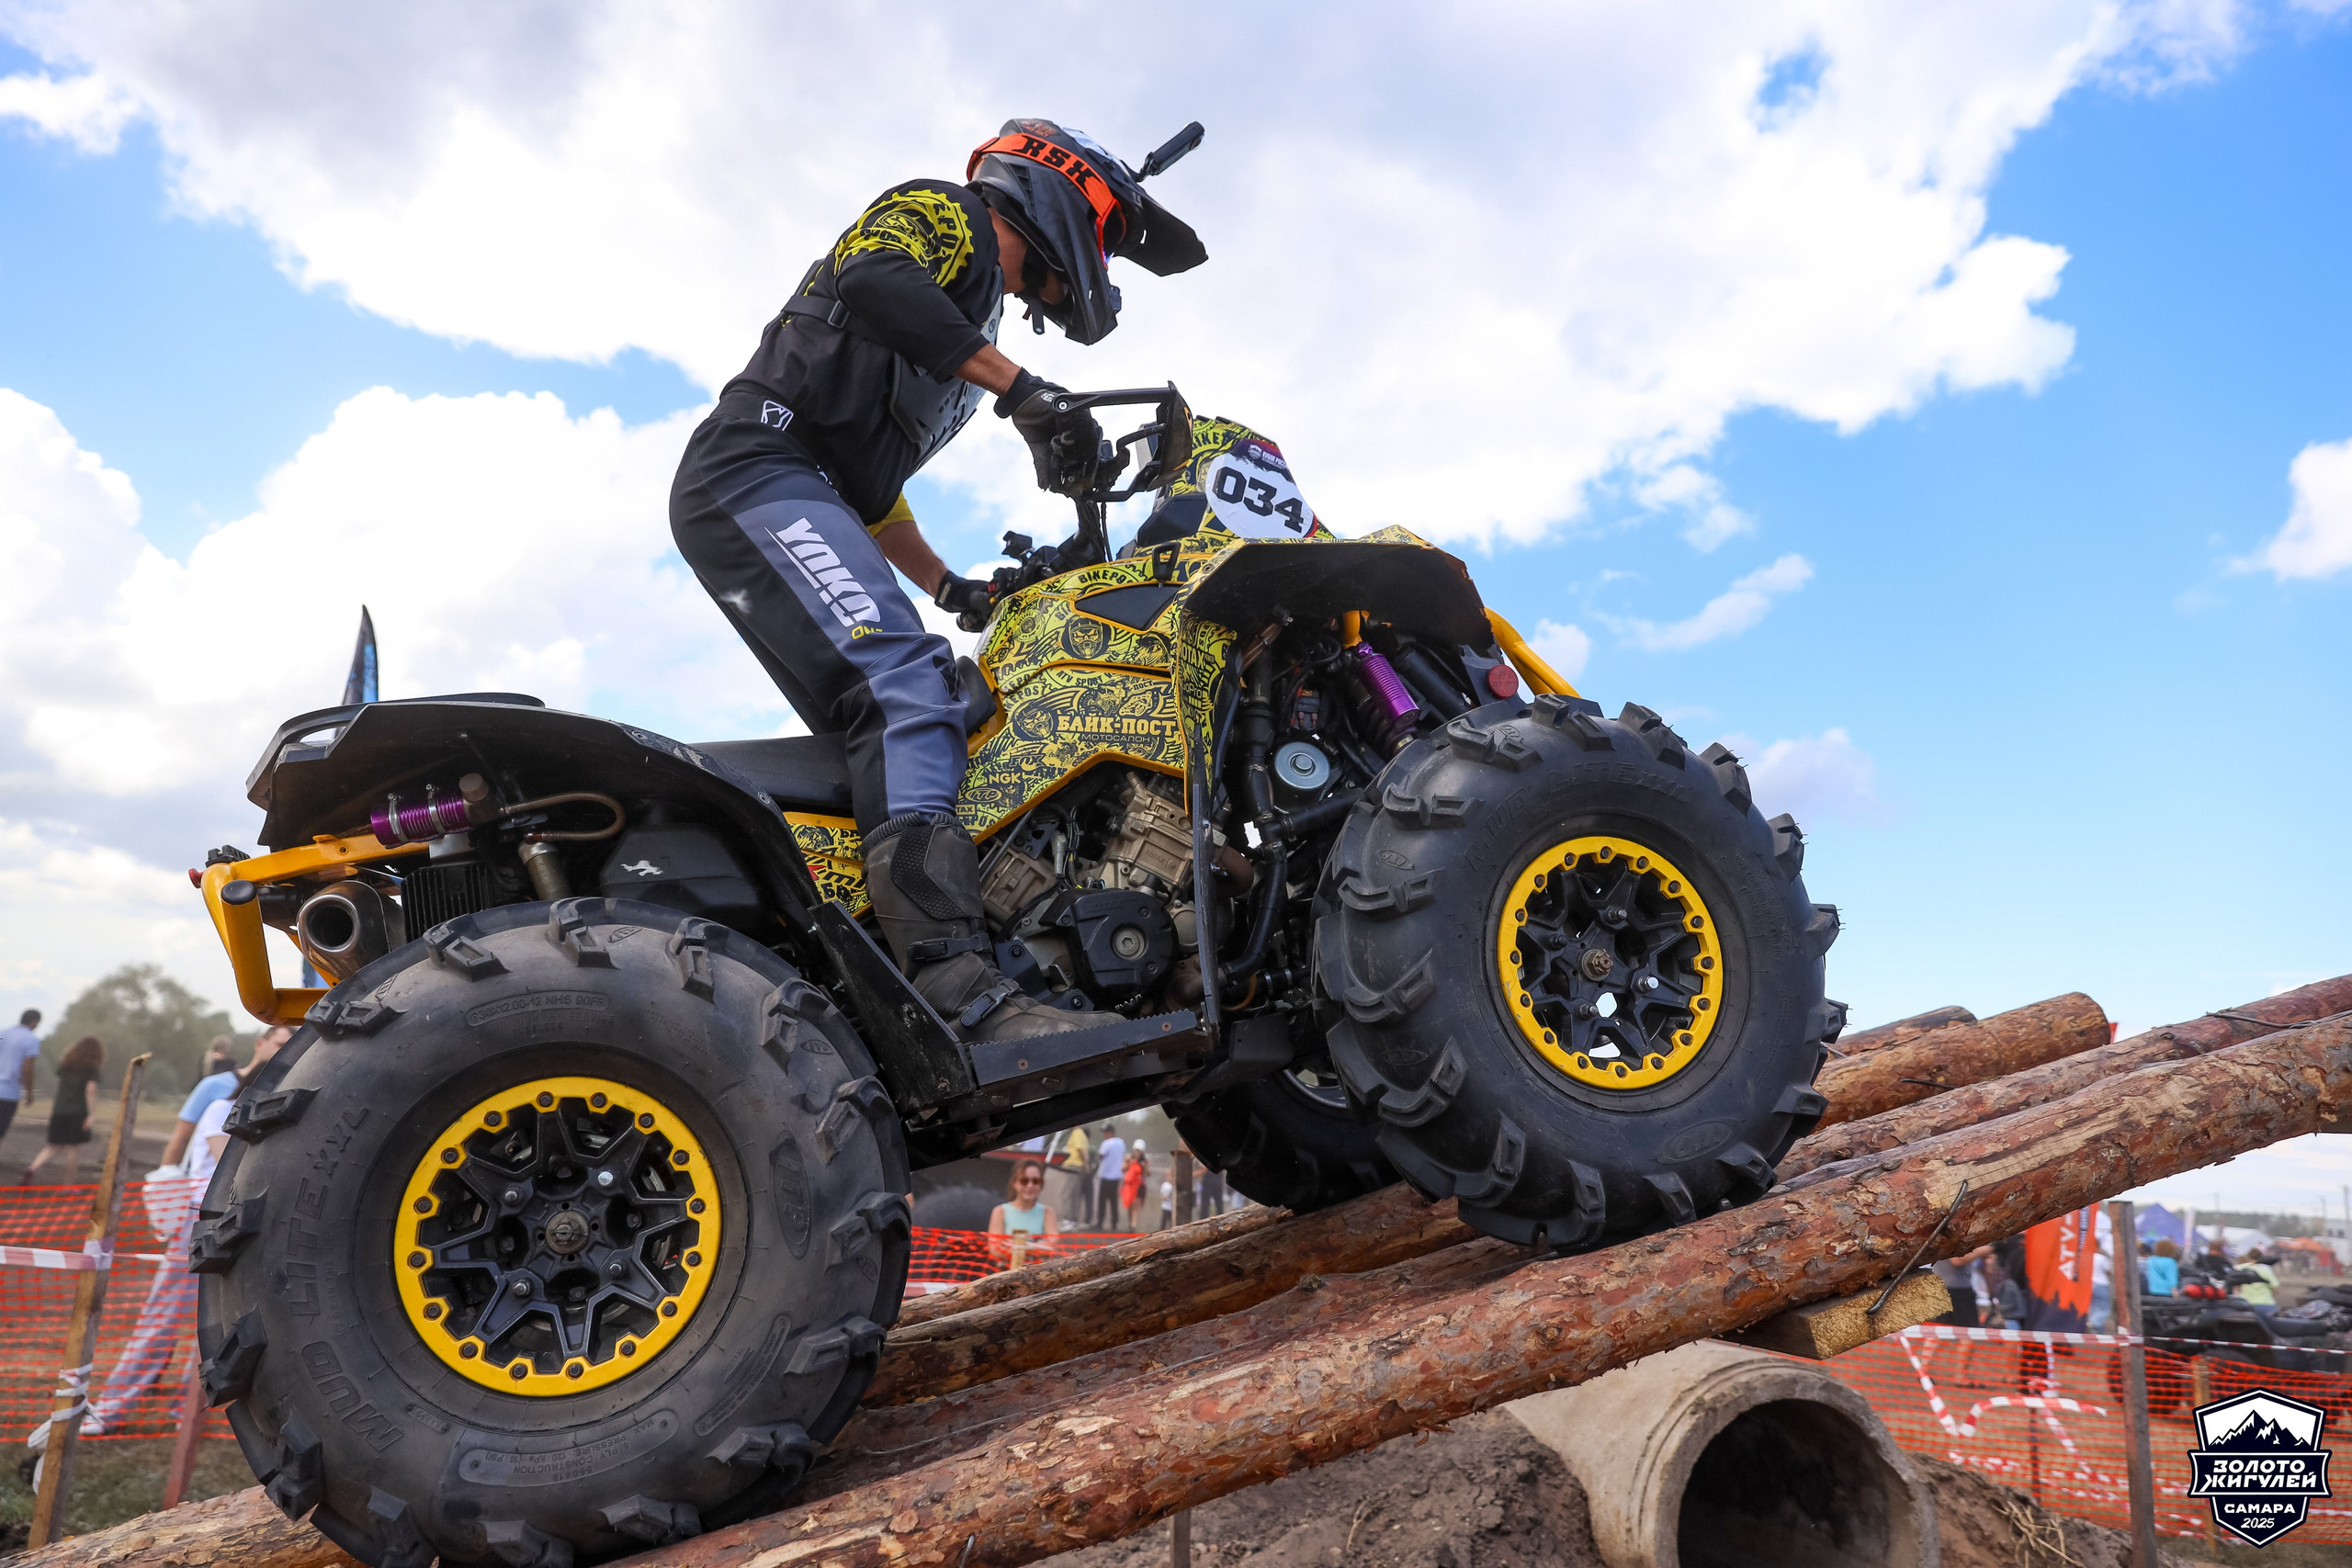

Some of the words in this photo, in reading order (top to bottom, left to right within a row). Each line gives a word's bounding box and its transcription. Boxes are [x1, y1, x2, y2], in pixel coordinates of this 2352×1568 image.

[1012, 135, 1102, 197] RSK
[1212, 466, 1304, 534] 034
[775, 517, 881, 628] YOKO
[1056, 671, 1074, 683] ATV
[1057, 713, 1176, 737] БАЙК-ПОСТ
[1081, 734, 1150, 743] МОТОСАЛОН
[1009, 753, 1046, 768] FOX
[989, 772, 1022, 784] NGK
[968, 790, 999, 801] ITP
[1464, 786, 1530, 872] MUD
[1547, 761, 1635, 794] LITE
[545, 992, 571, 1005] NHS
[287, 1177, 329, 1315] LITE
[301, 1340, 405, 1452] MUD
[551, 1452, 568, 1461] 120
[599, 1446, 618, 1461] PLY
[513, 1455, 594, 1475] CONSTRUCTION
